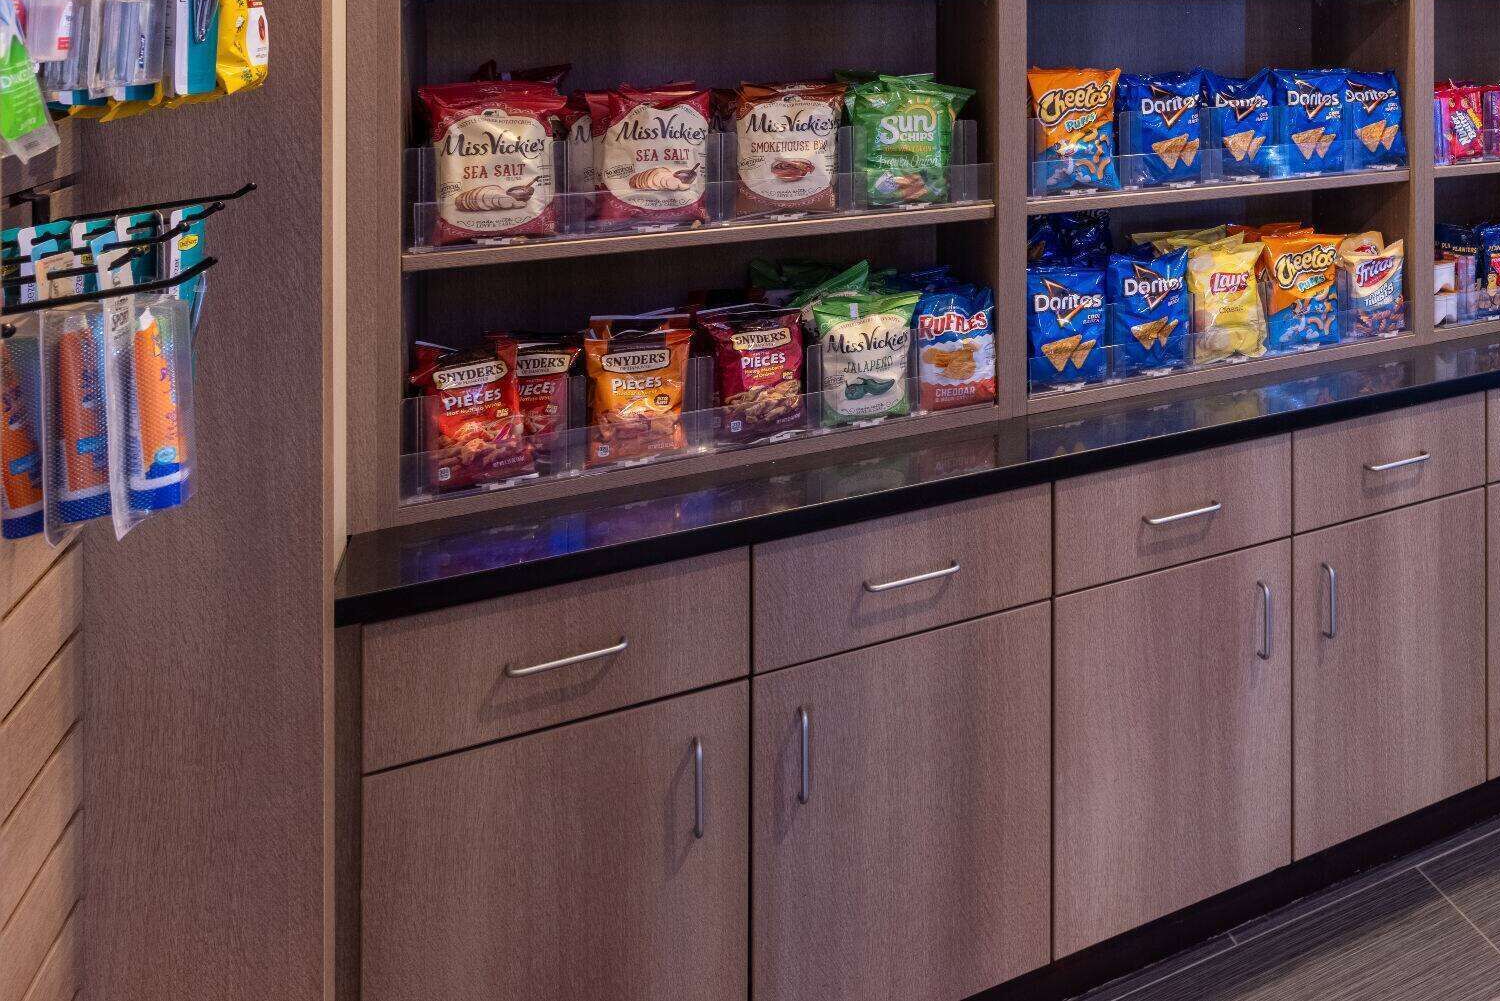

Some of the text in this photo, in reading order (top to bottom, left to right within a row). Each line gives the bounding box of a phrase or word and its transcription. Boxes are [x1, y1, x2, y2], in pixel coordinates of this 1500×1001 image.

[1038, 82, 1113, 125] Cheetos
[1288, 90, 1340, 106] Doritos
[1346, 88, 1397, 103] Doritos
[616, 117, 706, 145] Miss Vickie's
[749, 113, 838, 136] Miss Vickie's
[879, 114, 936, 145] Sun
[1065, 113, 1098, 132] Puffs
[441, 131, 545, 160] Miss Vickie's
[900, 132, 934, 142] CHIPS
[636, 149, 690, 162] SEA SALT
[751, 141, 810, 153] SMOKEHOUSE
[464, 163, 526, 179] SEA SALT
[1452, 246, 1477, 254] PLANTERS
[1275, 247, 1338, 288] Cheetos
[1355, 256, 1394, 288] Fritos
[1124, 276, 1184, 296] Doritos
[1211, 272, 1249, 293] Lay's
[1298, 275, 1326, 293] Puffs
[1034, 293, 1103, 312] Doritos
[919, 311, 988, 340] RUFFLES
[735, 330, 787, 345] SNYDER'S
[827, 326, 909, 354] Miss Vickie's
[605, 352, 666, 368] SNYDER'S
[741, 353, 786, 369] PIECES
[437, 361, 504, 385] SNYDER'S
[612, 377, 662, 393] PIECES
[936, 387, 976, 397] CHEDDAR
[444, 388, 502, 410] PIECES
